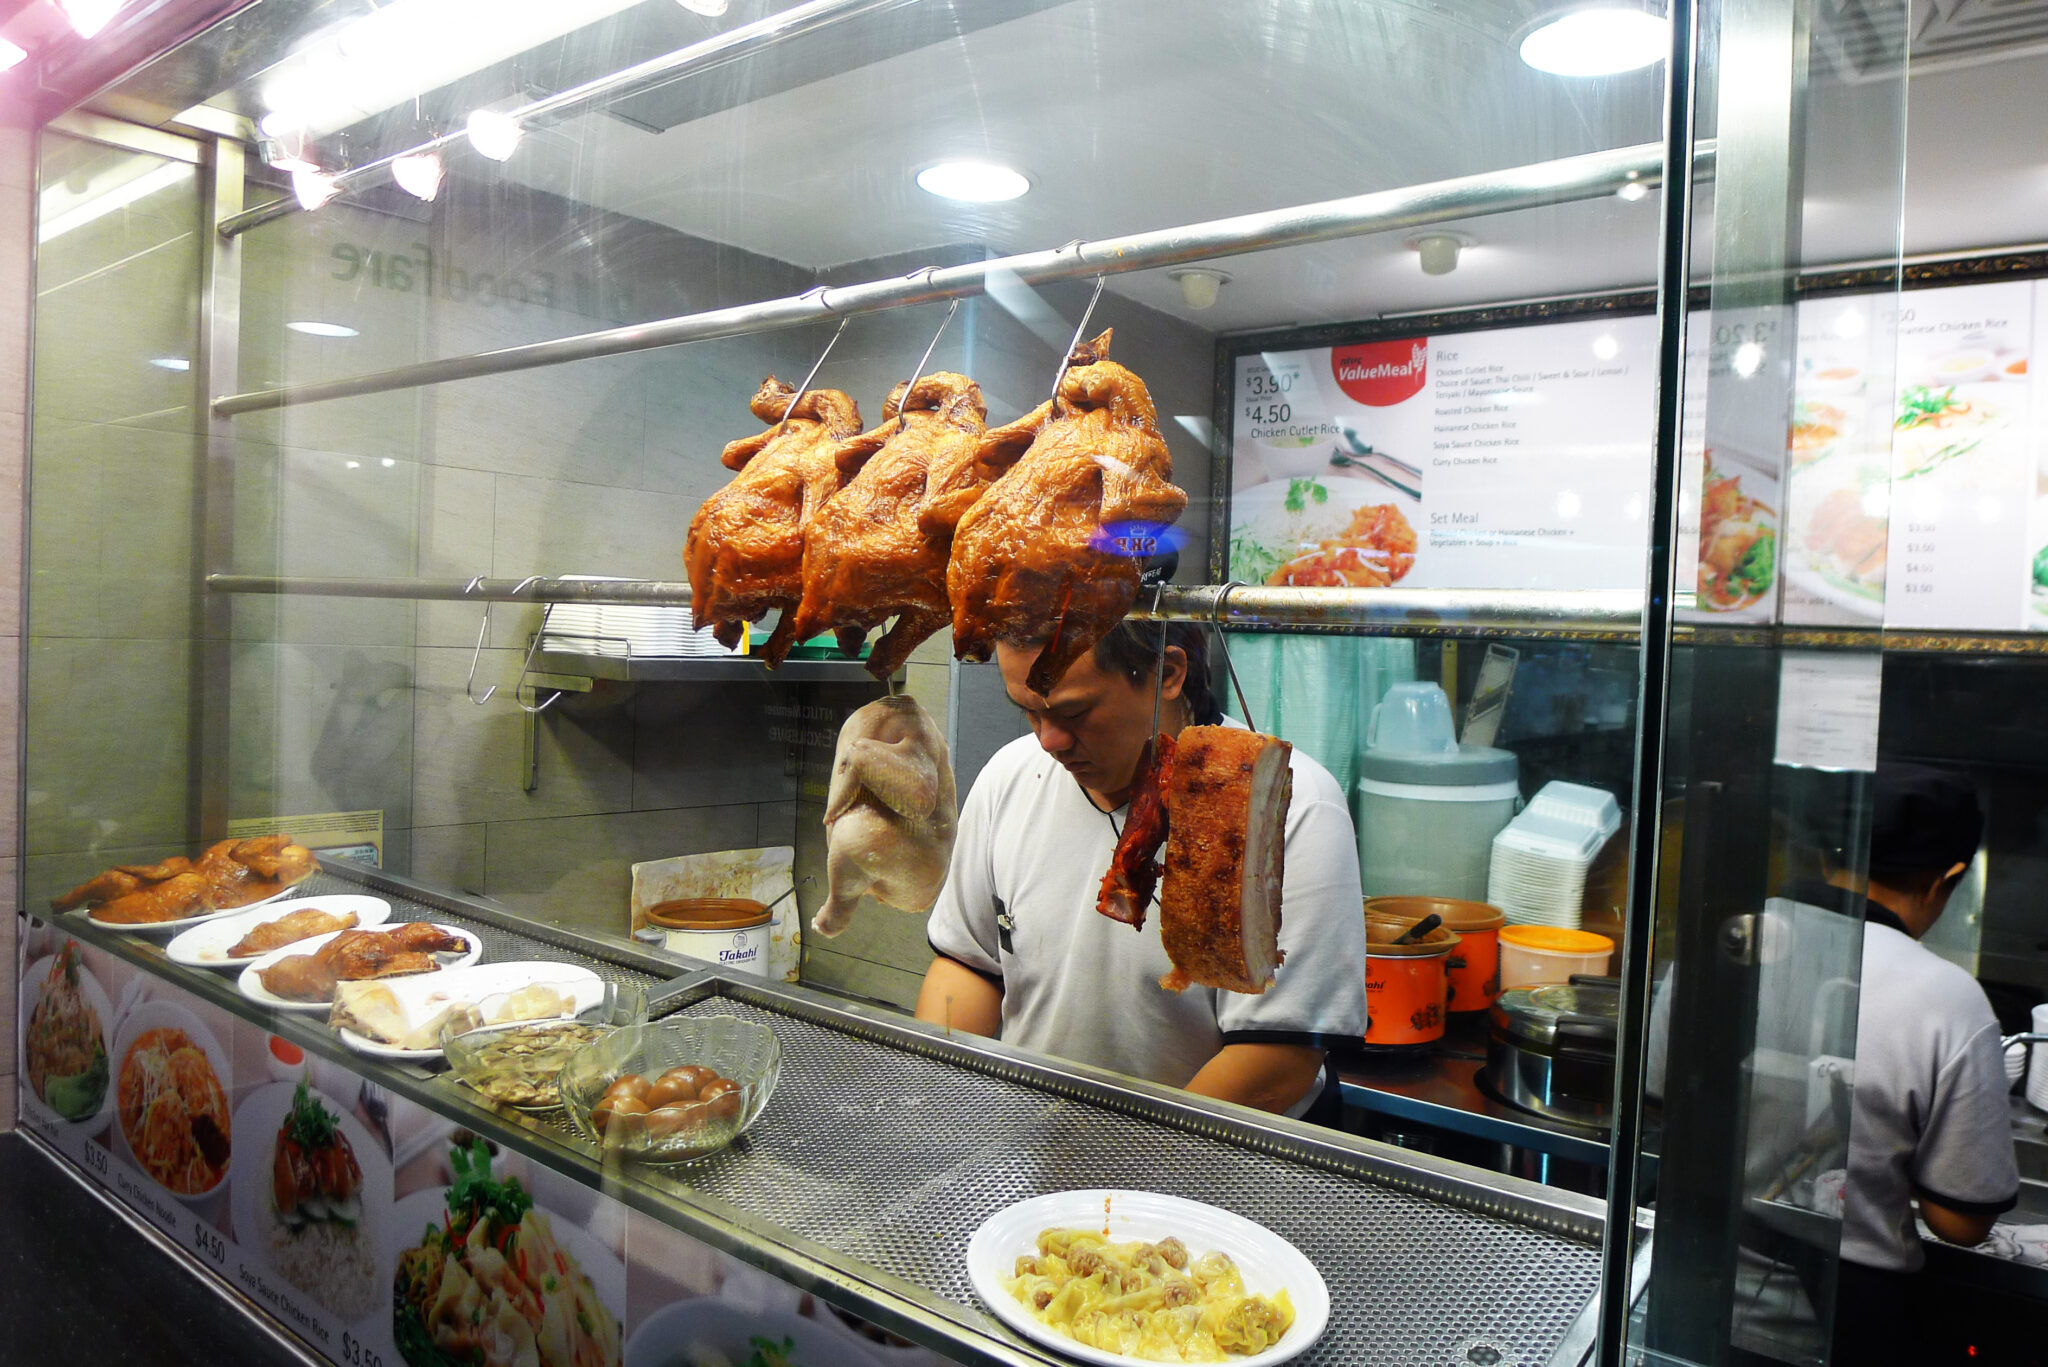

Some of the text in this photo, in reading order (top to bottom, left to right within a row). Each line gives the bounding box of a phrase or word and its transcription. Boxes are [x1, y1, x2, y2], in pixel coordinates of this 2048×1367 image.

[1436, 350, 1459, 362] Rice
[1338, 360, 1413, 381] ValueMeal
[1245, 403, 1292, 424] $4.50
[1494, 404, 1508, 412] Rice
[1251, 423, 1340, 439] Chicken Cutlet Rice
[1501, 421, 1517, 429] Rice
[1504, 438, 1520, 446] Rice
[1430, 512, 1479, 524] Set Meal
[85, 1140, 108, 1175] $3.50
[195, 1224, 225, 1264] $4.50
[239, 1263, 329, 1344] Soya Sauce Chicken Rice
